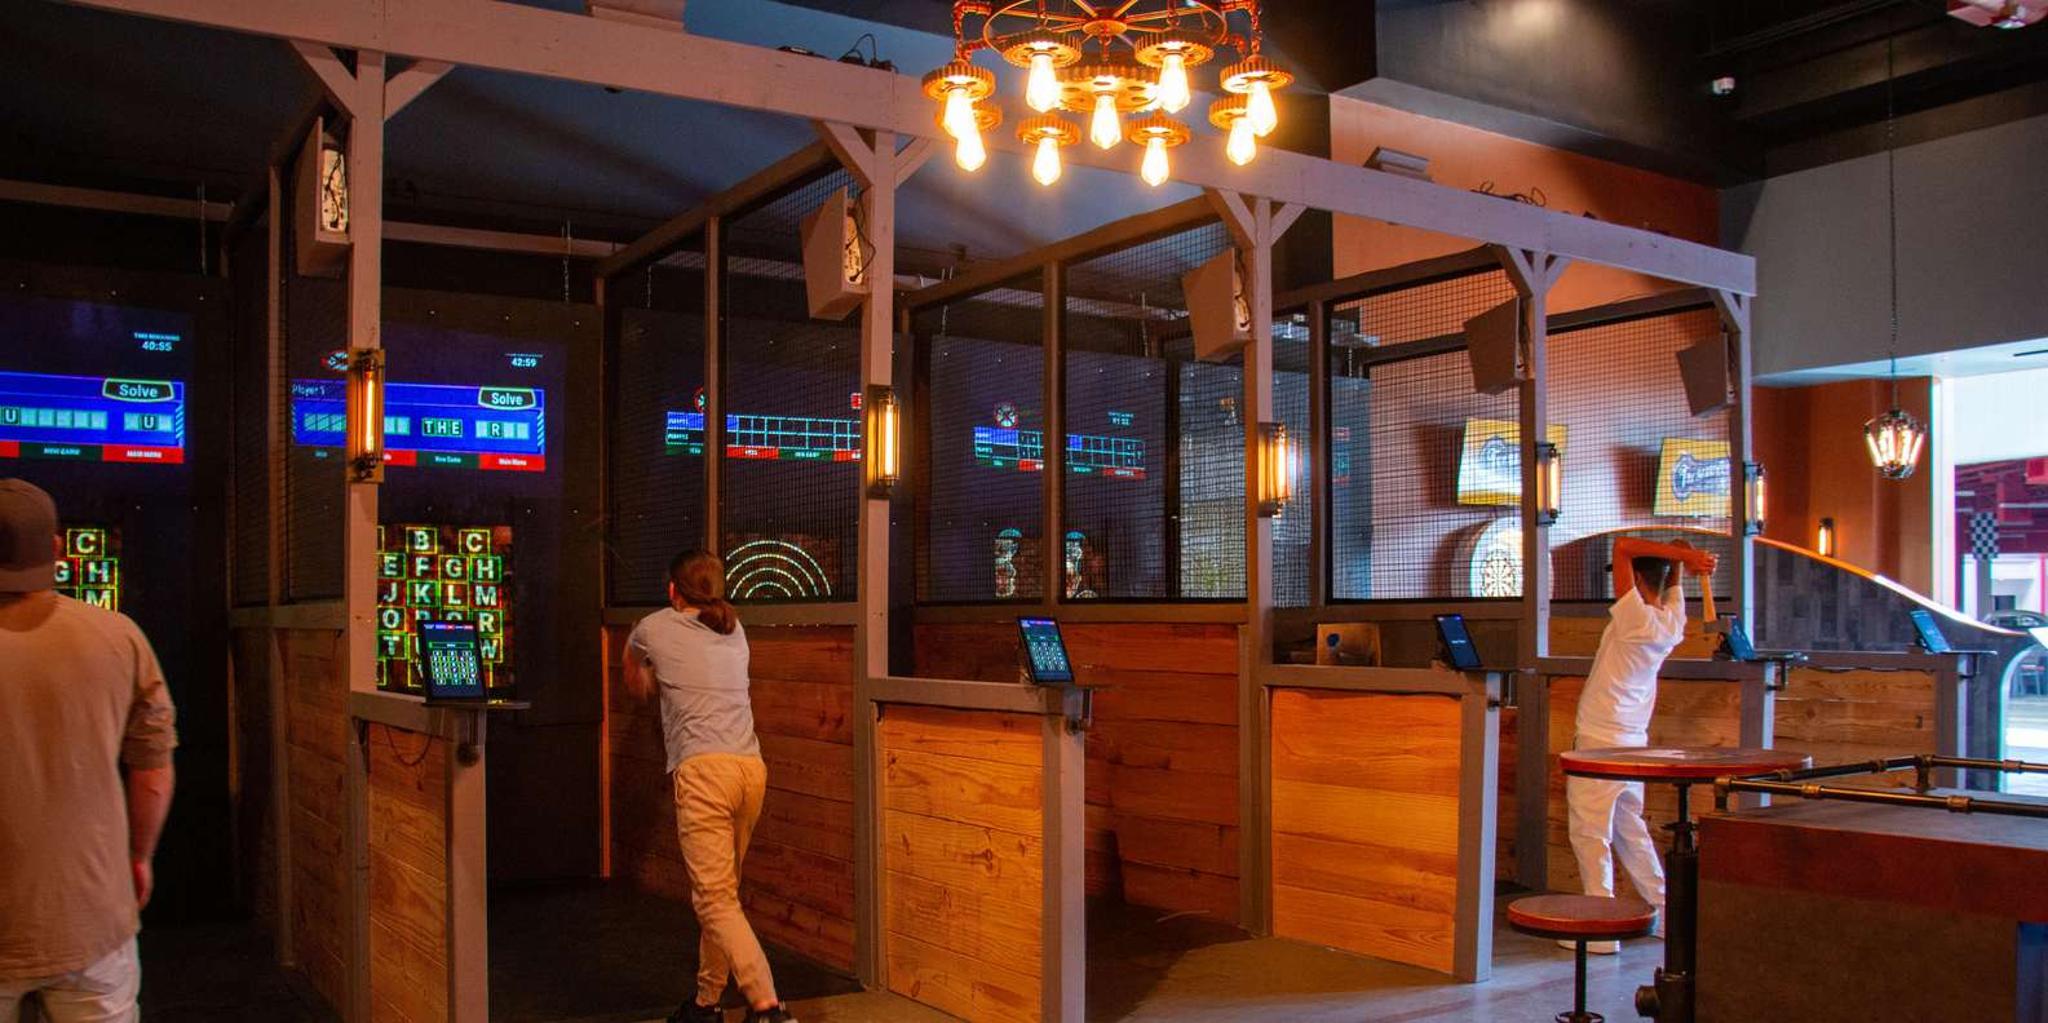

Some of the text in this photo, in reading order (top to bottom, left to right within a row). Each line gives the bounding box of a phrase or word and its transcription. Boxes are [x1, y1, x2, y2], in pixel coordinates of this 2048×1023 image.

[511, 357, 537, 368] 42:59
[119, 384, 158, 399] Solve
[491, 392, 523, 406] Solve
[5, 409, 17, 423] U
[144, 415, 155, 429] U
[424, 419, 461, 436] THE
[491, 422, 501, 437] R
[76, 533, 96, 554] C
[414, 531, 482, 552] B C
[54, 560, 110, 583] G H
[384, 556, 494, 579] E F G H
[86, 589, 111, 610] M
[383, 582, 497, 606] J K L M
[382, 609, 400, 628] O
[479, 613, 495, 632] R
[383, 636, 400, 655] T
